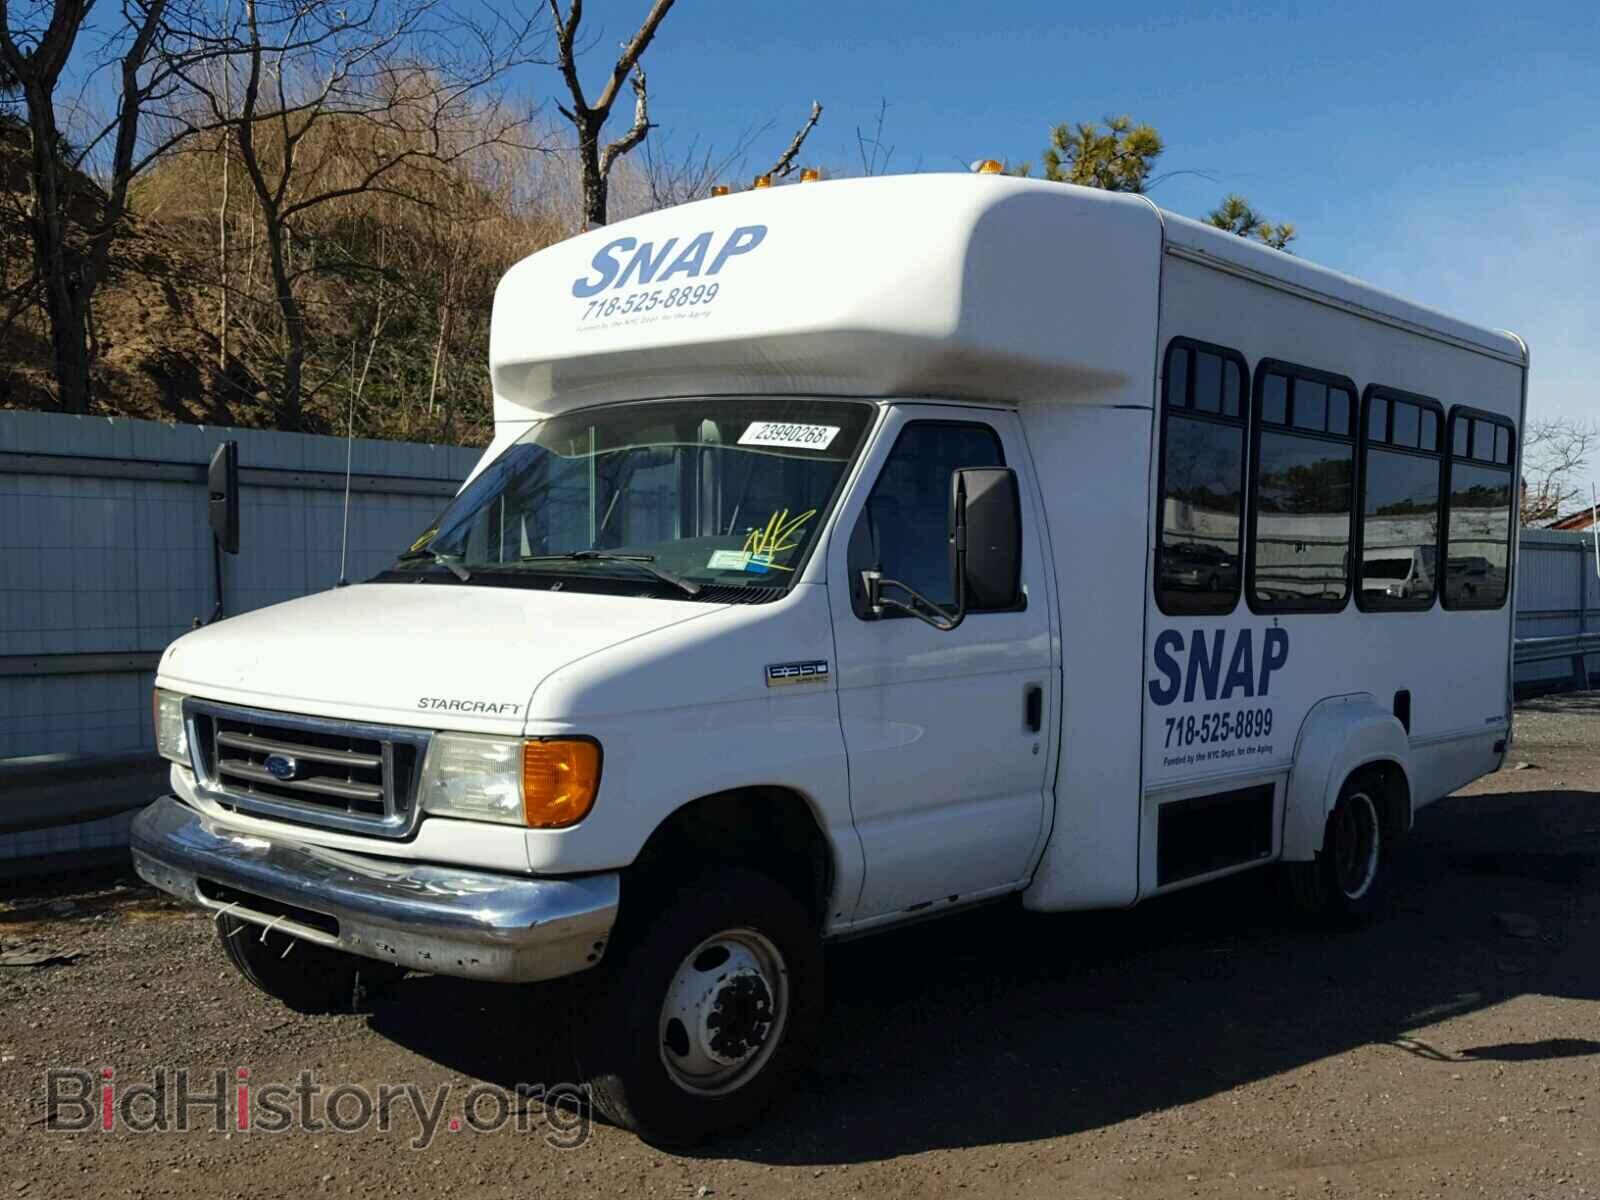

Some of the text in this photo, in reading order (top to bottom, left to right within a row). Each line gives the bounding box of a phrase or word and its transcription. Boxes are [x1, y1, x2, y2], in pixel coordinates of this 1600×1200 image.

[572, 224, 768, 299] SNAP
[582, 283, 720, 320] 718-525-8899
[755, 423, 828, 444] 23990268
[1148, 627, 1289, 706] SNAP
[417, 697, 524, 715] STARCRAFT
[1164, 707, 1273, 749] 718-525-8899
[1207, 750, 1220, 760] NYC
